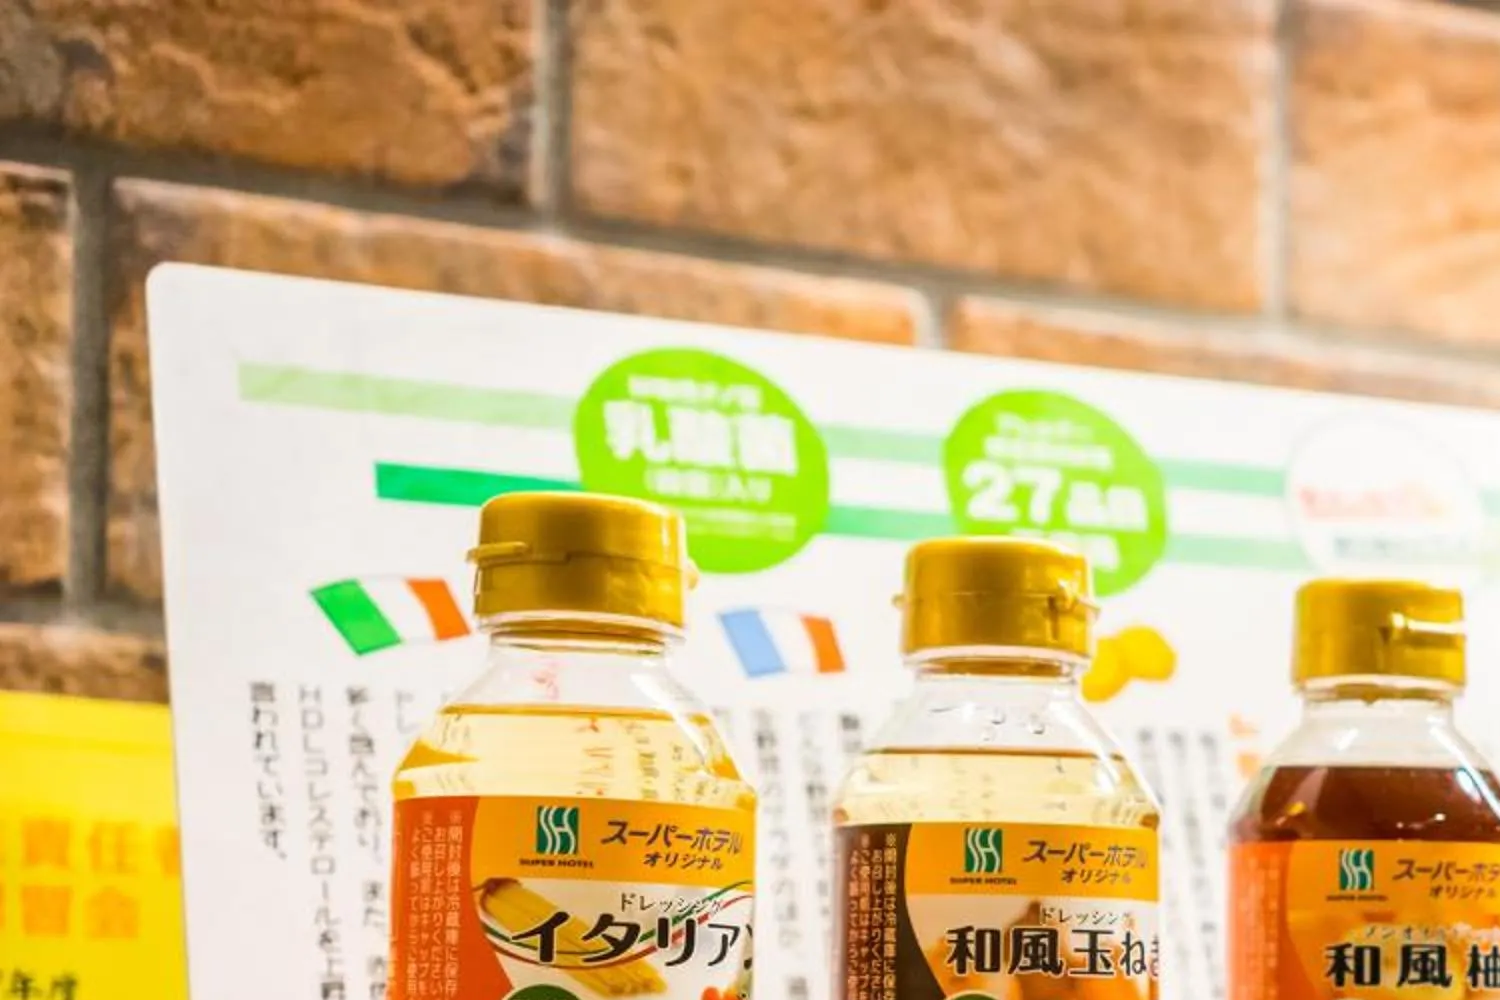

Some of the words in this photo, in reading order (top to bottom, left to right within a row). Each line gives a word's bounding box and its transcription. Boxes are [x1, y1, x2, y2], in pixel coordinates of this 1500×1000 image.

[601, 820, 744, 854] スーパーホテル
[643, 853, 724, 870] オリジナル
